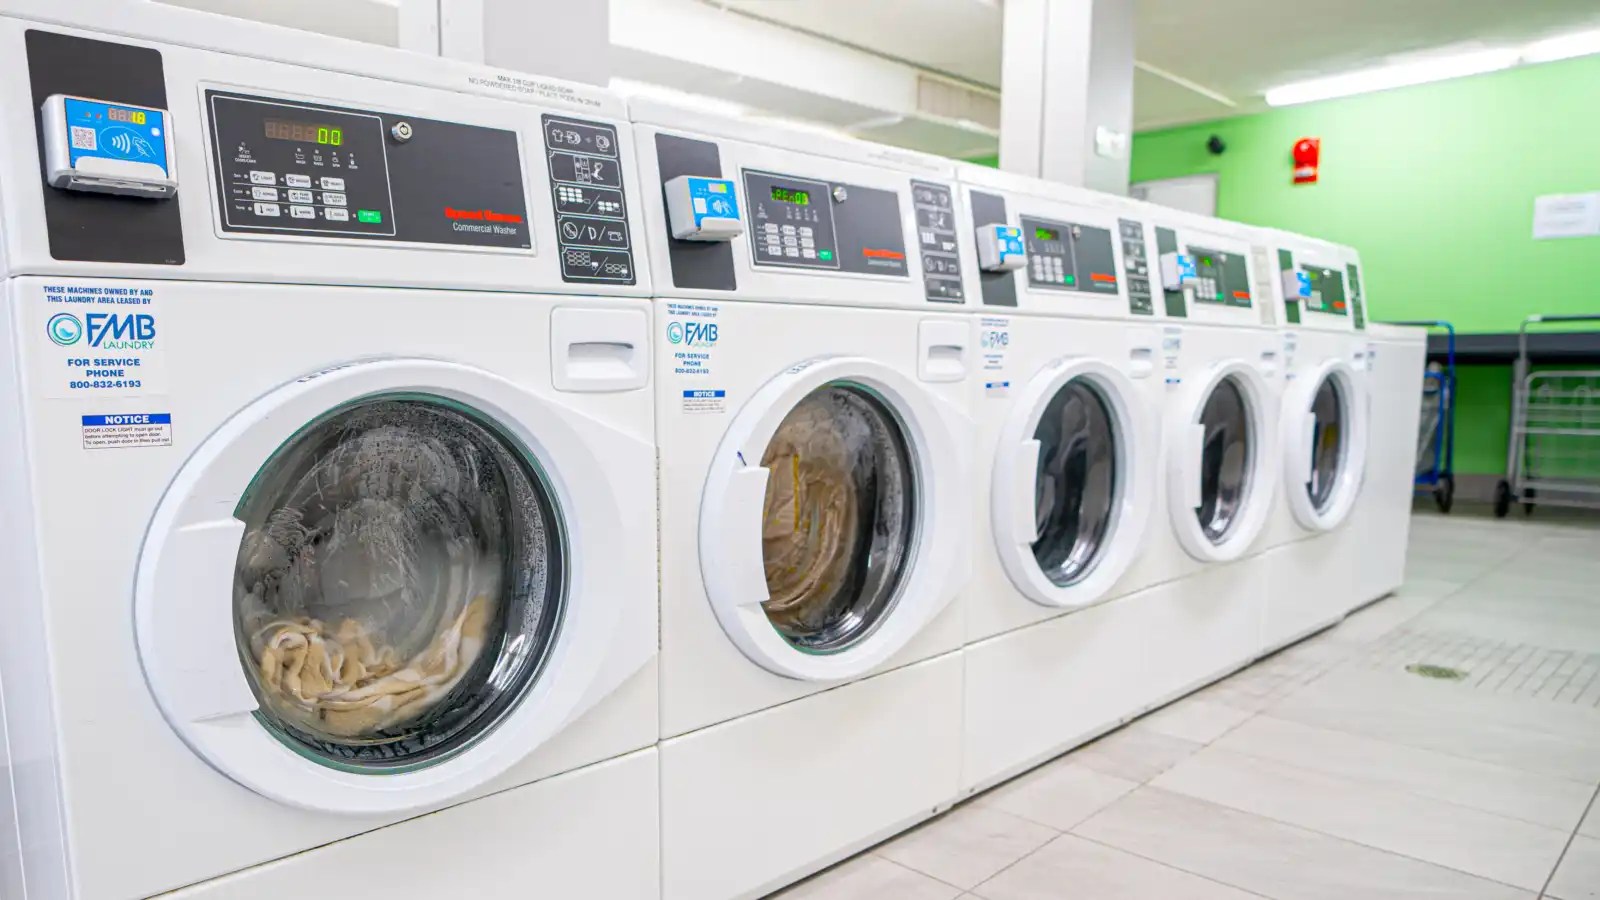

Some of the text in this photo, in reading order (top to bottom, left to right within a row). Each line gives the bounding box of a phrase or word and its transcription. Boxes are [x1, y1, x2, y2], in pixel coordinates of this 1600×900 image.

[452, 222, 516, 235] Commercial Washer
[67, 287, 102, 295] MACHINES
[86, 313, 156, 347] FMB
[685, 322, 718, 345] FMB
[104, 341, 154, 349] LAUNDRY
[70, 380, 141, 388] 800-832-6193
[105, 415, 150, 424] NOTICE
